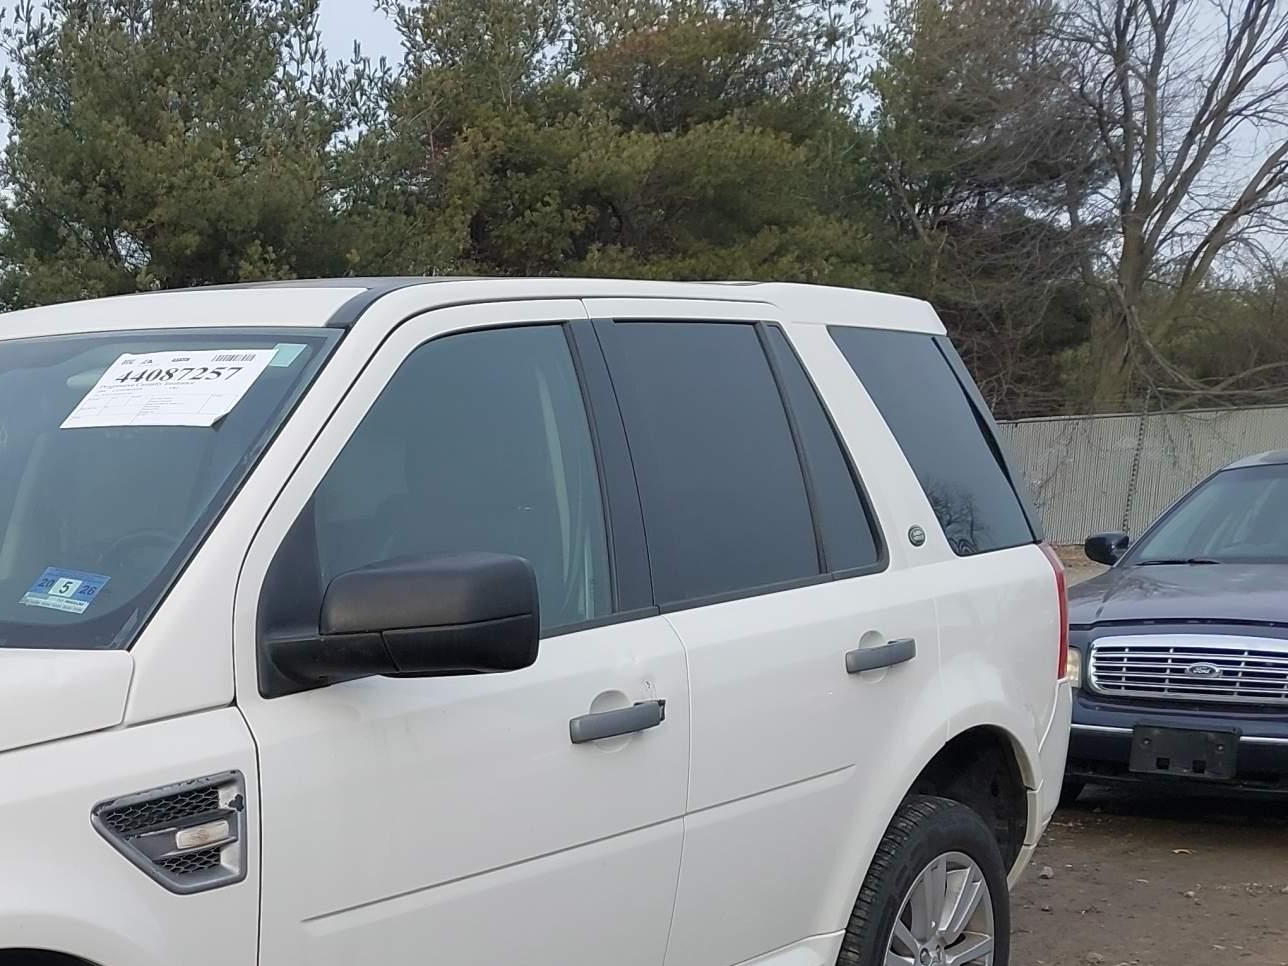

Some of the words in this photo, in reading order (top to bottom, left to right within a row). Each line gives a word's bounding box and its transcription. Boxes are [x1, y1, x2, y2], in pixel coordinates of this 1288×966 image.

[115, 366, 243, 383] 44087257
[59, 581, 73, 594] 5
[78, 585, 97, 595] 26
